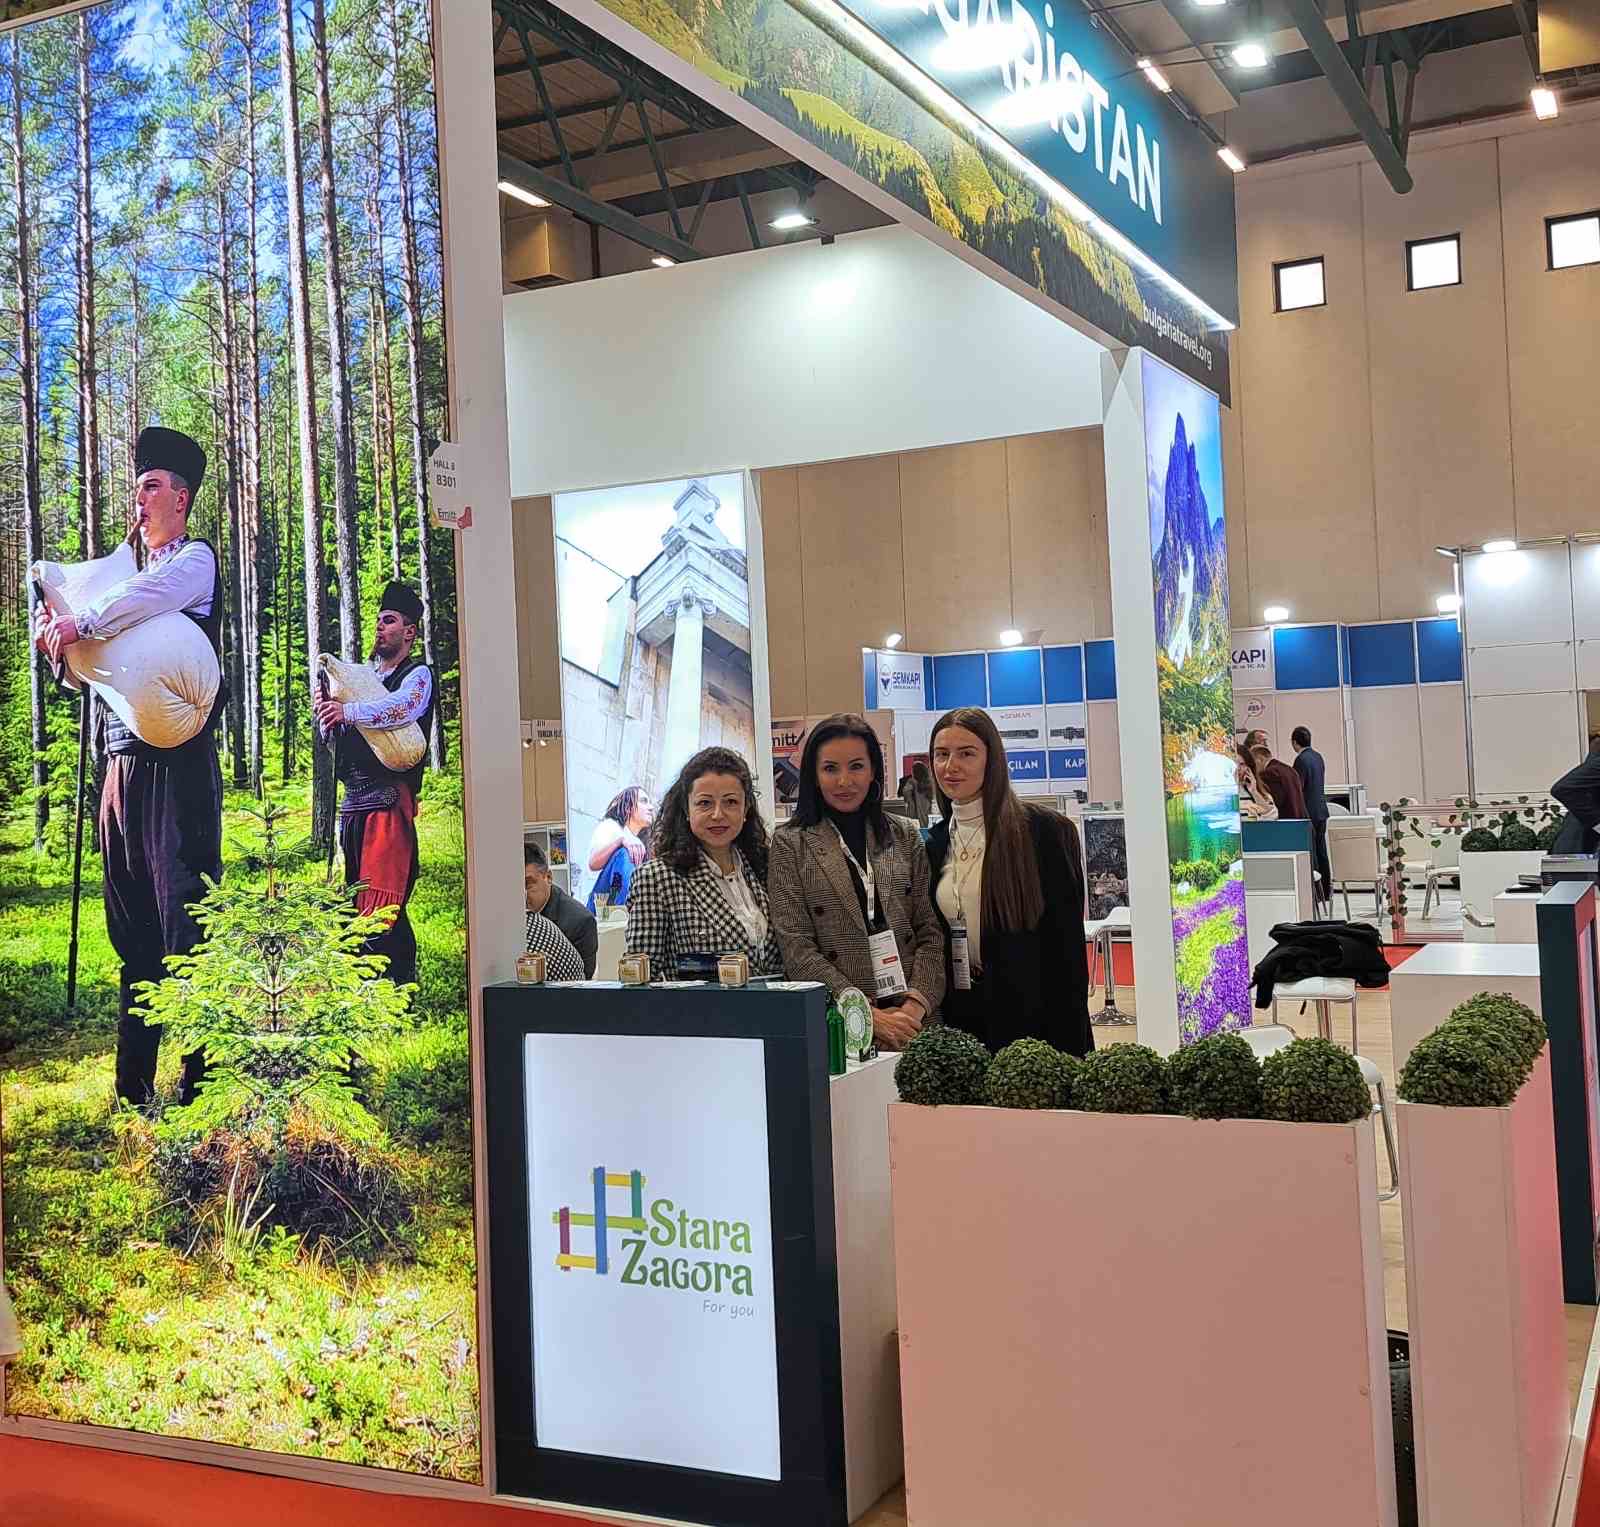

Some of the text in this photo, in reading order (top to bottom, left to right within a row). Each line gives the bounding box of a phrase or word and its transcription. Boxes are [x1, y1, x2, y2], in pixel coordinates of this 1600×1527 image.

[1142, 300, 1213, 371] bulgariatravel.org
[433, 459, 450, 470] HALL
[649, 1198, 753, 1254] Stara
[702, 1299, 755, 1319] For you
